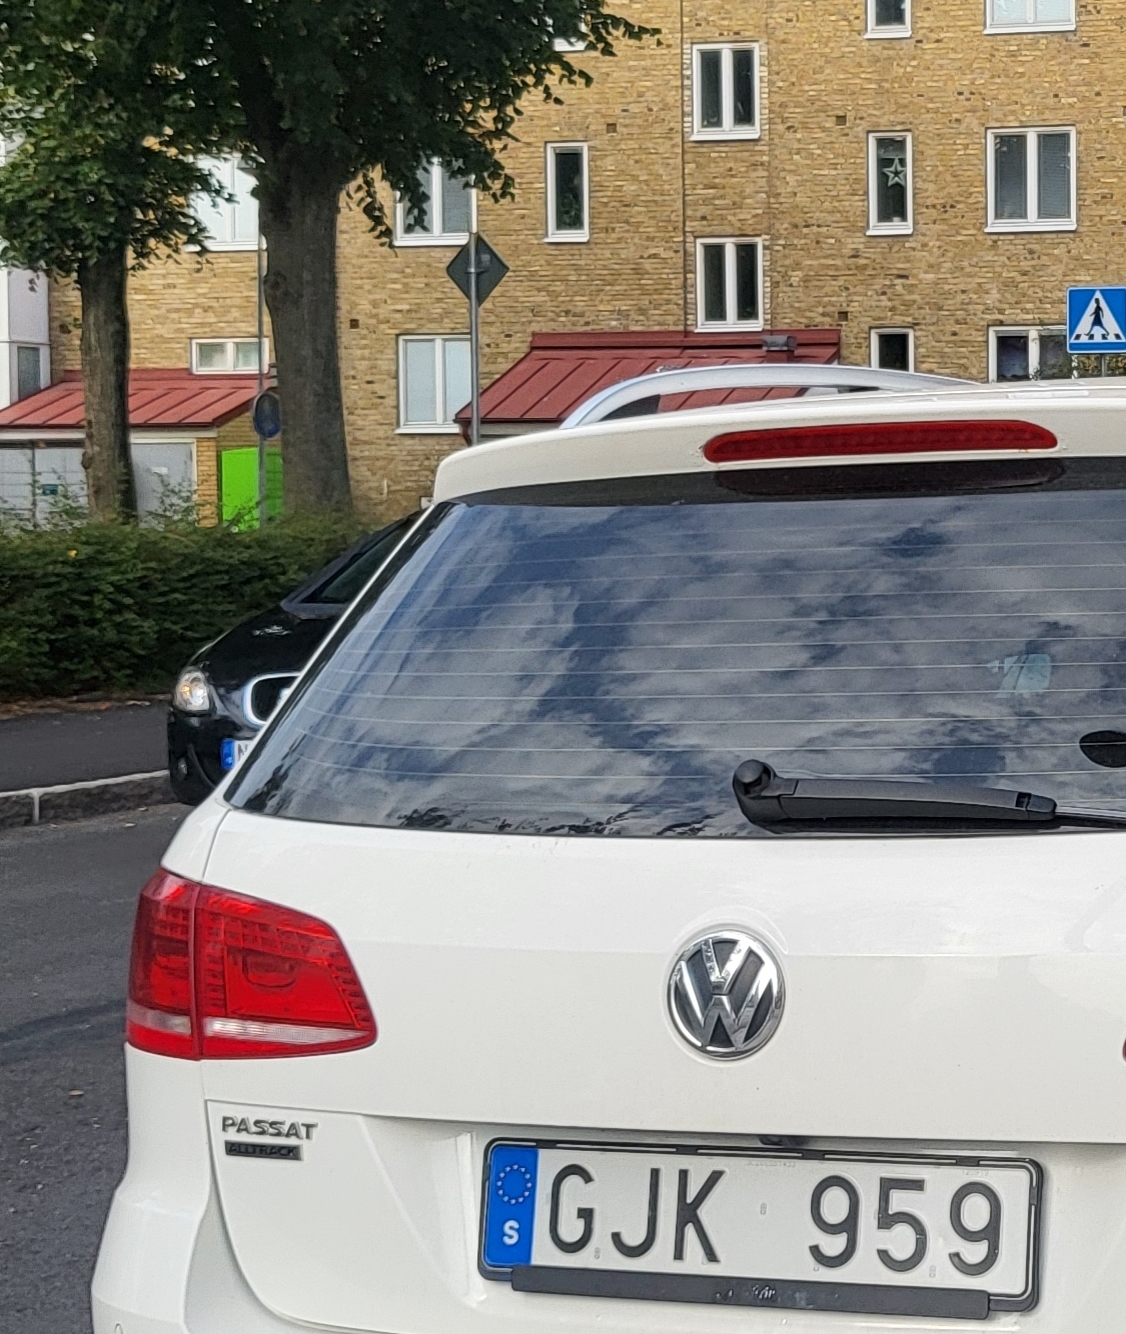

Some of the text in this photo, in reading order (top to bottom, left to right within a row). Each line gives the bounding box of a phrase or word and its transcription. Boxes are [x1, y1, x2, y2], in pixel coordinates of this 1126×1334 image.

[671, 931, 784, 1055] VW
[221, 1115, 318, 1141] PASSAT
[228, 1143, 297, 1158] ALLTRACK
[502, 1219, 520, 1246] S
[548, 1163, 1002, 1276] GJK 959
